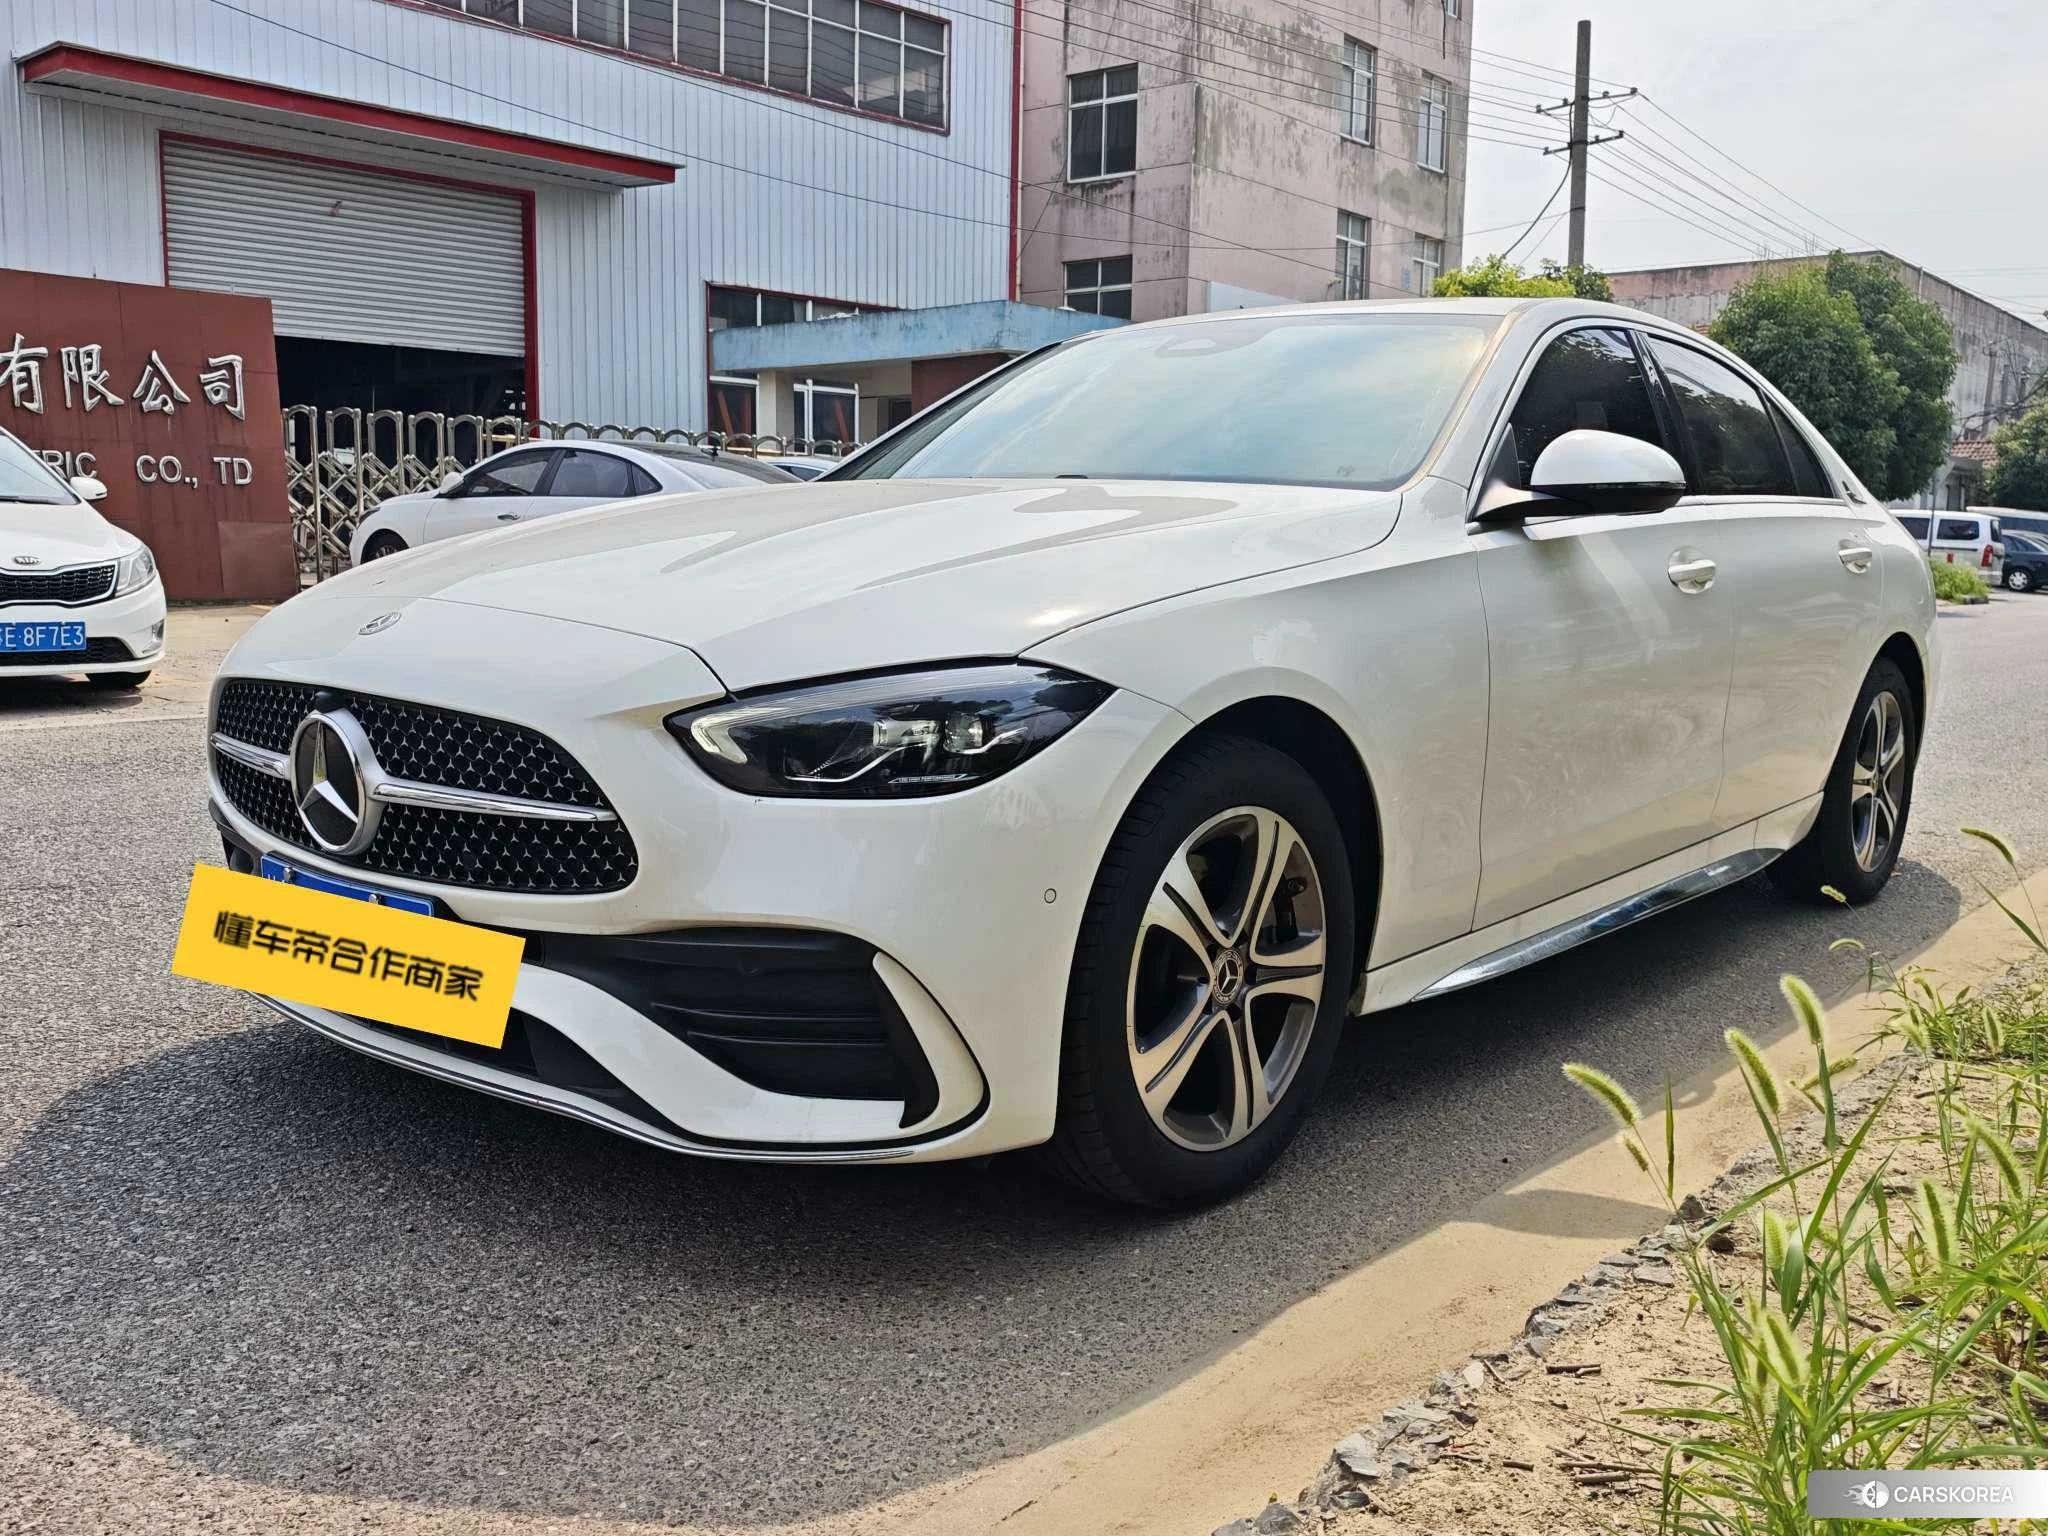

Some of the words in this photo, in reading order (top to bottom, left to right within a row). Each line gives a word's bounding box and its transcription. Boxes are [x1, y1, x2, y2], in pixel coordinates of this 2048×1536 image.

[0, 333, 247, 420] 有限公司
[29, 449, 97, 478] RIC
[136, 455, 198, 489] CO.,
[213, 456, 252, 485] TD
[0, 626, 84, 647] E·8F7E3
